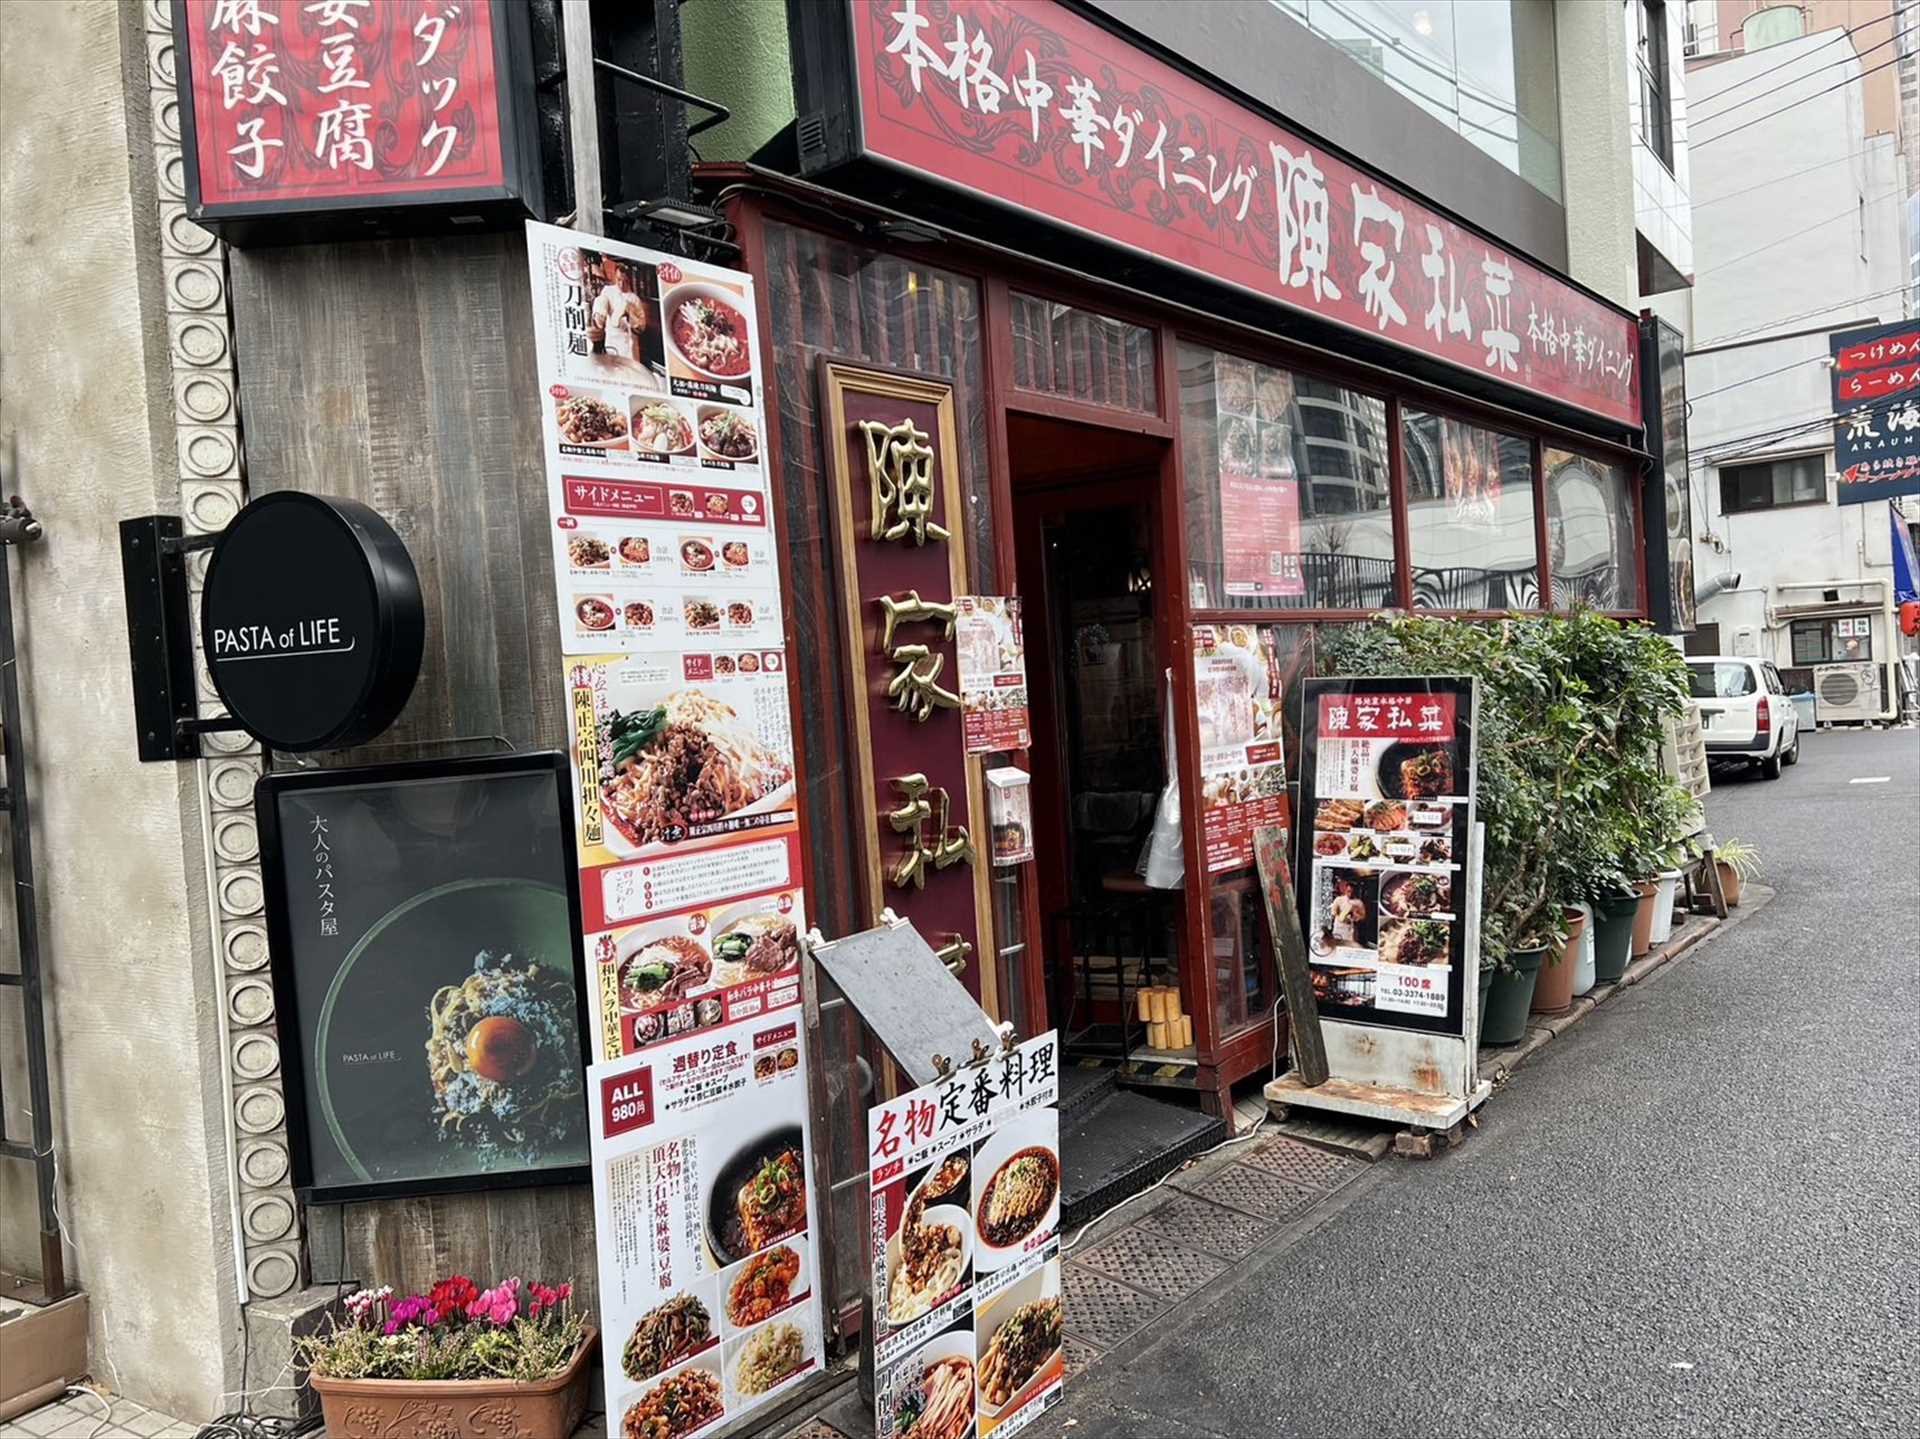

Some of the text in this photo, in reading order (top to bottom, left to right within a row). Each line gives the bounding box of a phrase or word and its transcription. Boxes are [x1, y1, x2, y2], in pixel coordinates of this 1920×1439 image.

[886, 0, 1258, 222] 本格中華ダイニング
[1269, 140, 1520, 373] 陳家私菜
[564, 284, 588, 357] 刀削麺
[1526, 301, 1635, 387] 本格中華ダイニング
[574, 484, 656, 504] サイドメニュー
[214, 617, 341, 654] PASTA of LIFE
[1327, 705, 1443, 731] 陳家私菜
[309, 814, 340, 937] 大人のパスタ屋
[342, 1052, 370, 1063] PASTA
[378, 1050, 396, 1061] LIFE
[673, 1040, 737, 1073] 週替り定食
[611, 1082, 644, 1103] ALL
[872, 1042, 1056, 1158] 名物定番料理
[611, 1101, 646, 1123] 980円
